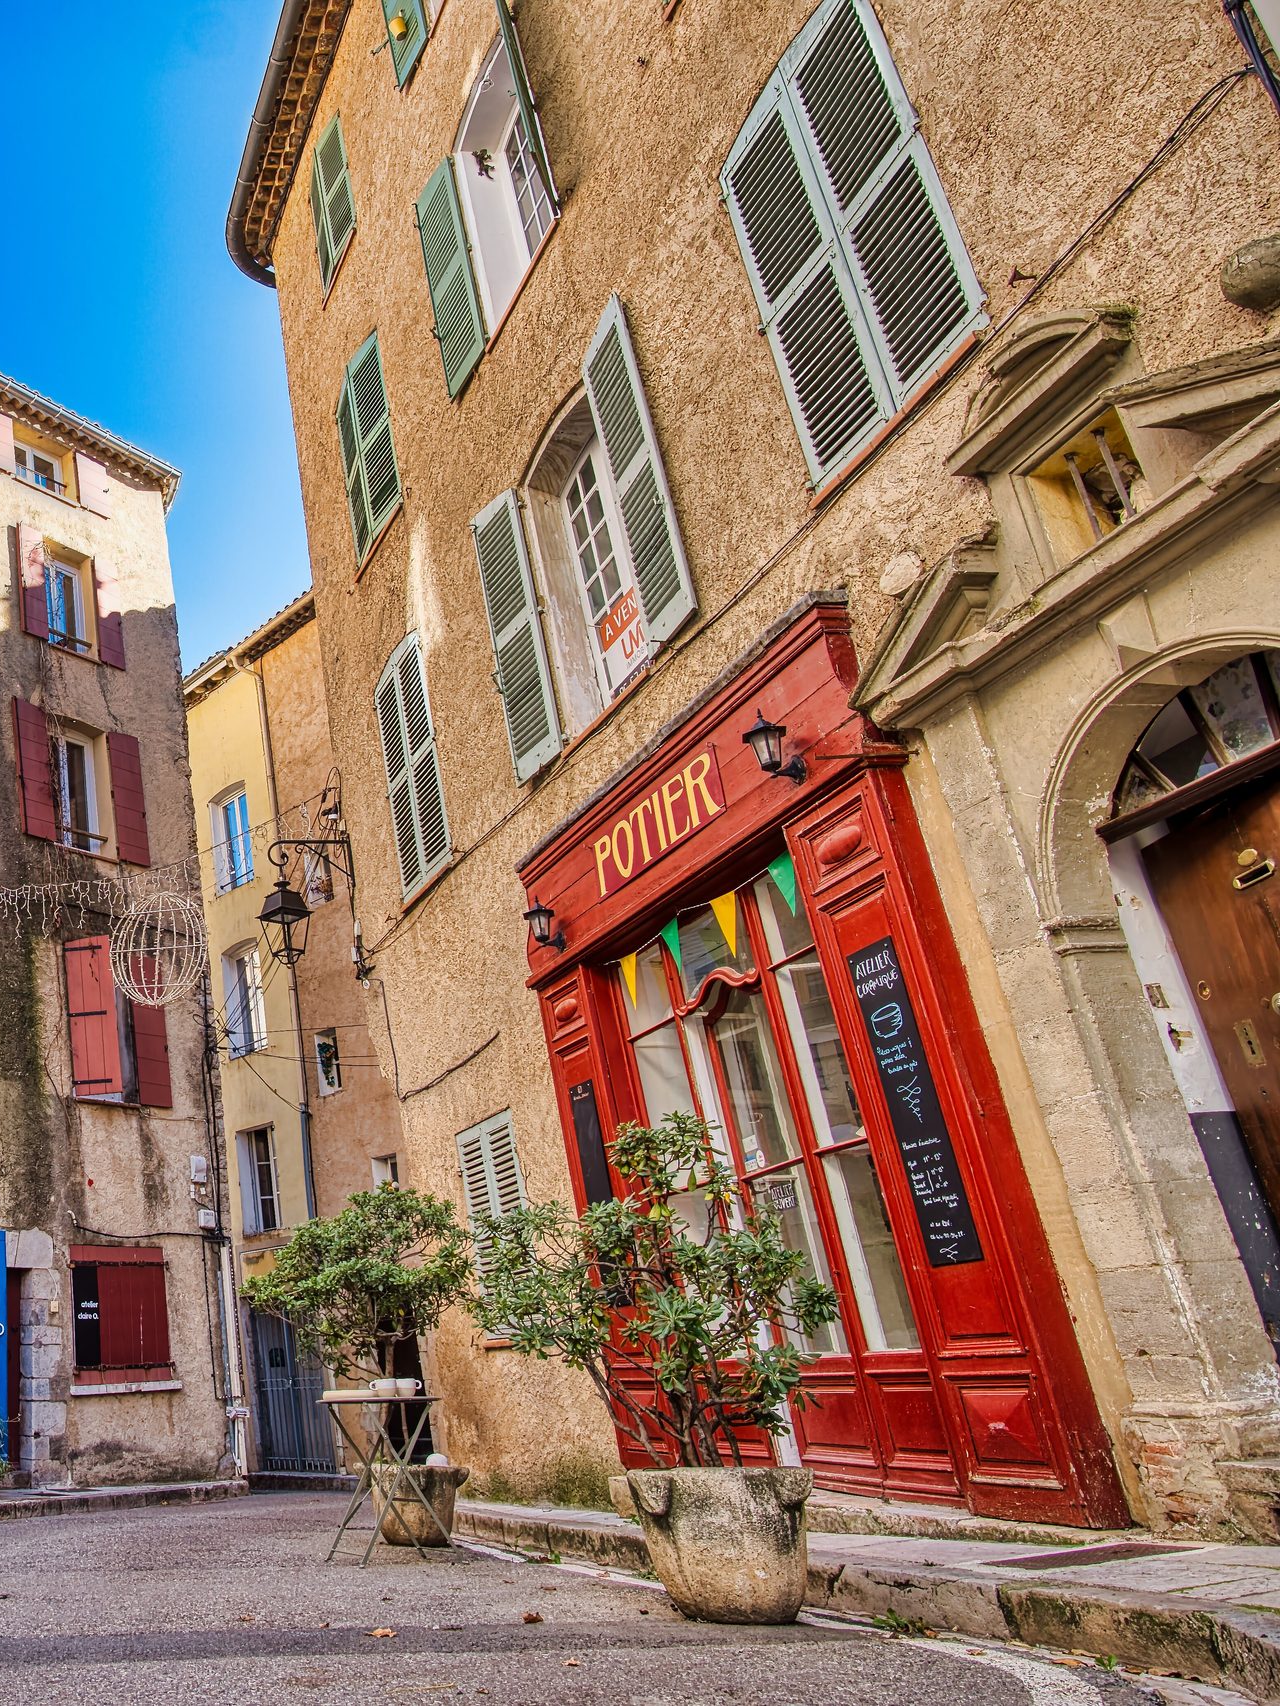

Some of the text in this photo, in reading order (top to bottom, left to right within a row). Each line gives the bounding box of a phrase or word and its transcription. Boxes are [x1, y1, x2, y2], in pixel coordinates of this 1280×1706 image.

[606, 623, 614, 641] A
[593, 752, 725, 898] POTIER
[856, 950, 897, 980] ATELIER
[80, 1300, 98, 1308] atelier
